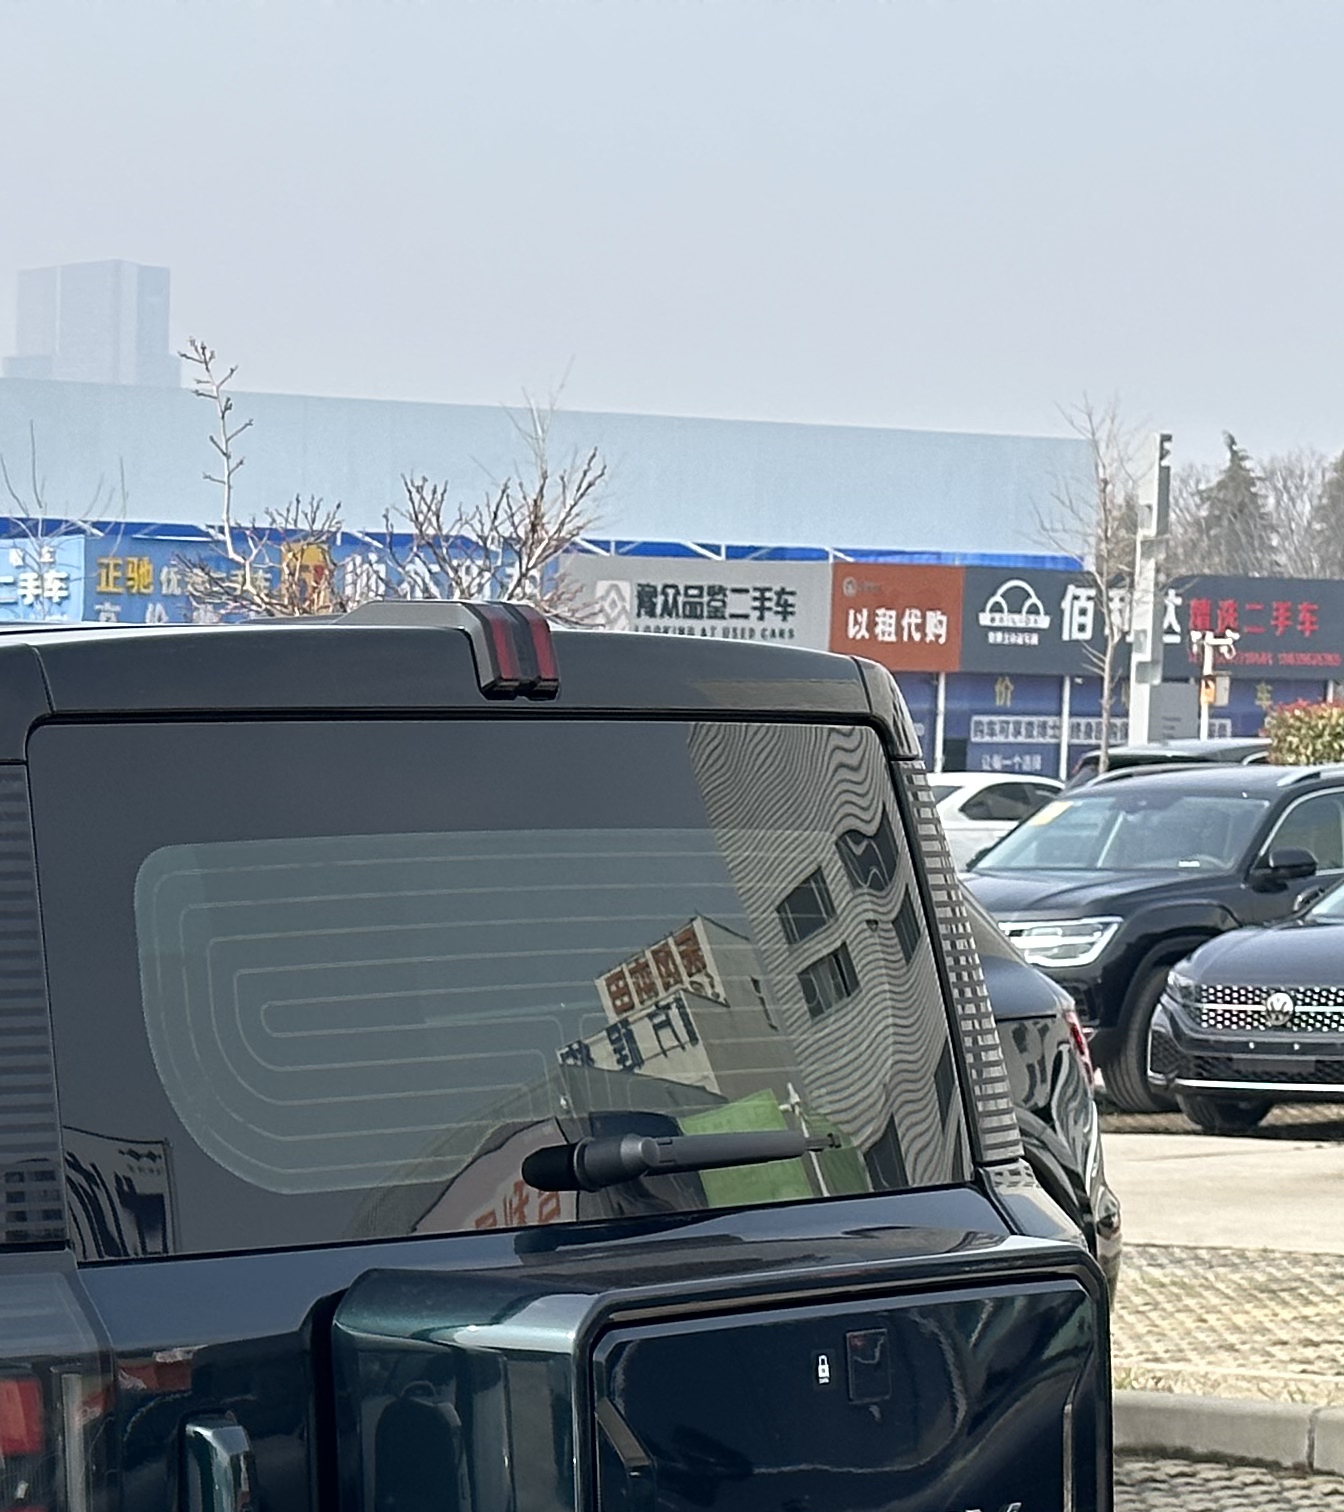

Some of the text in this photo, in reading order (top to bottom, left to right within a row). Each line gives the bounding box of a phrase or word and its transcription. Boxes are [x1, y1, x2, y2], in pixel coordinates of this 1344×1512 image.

[722, 627, 756, 640] USED
[760, 628, 795, 641] CARS
[847, 607, 947, 645] 以租代购
